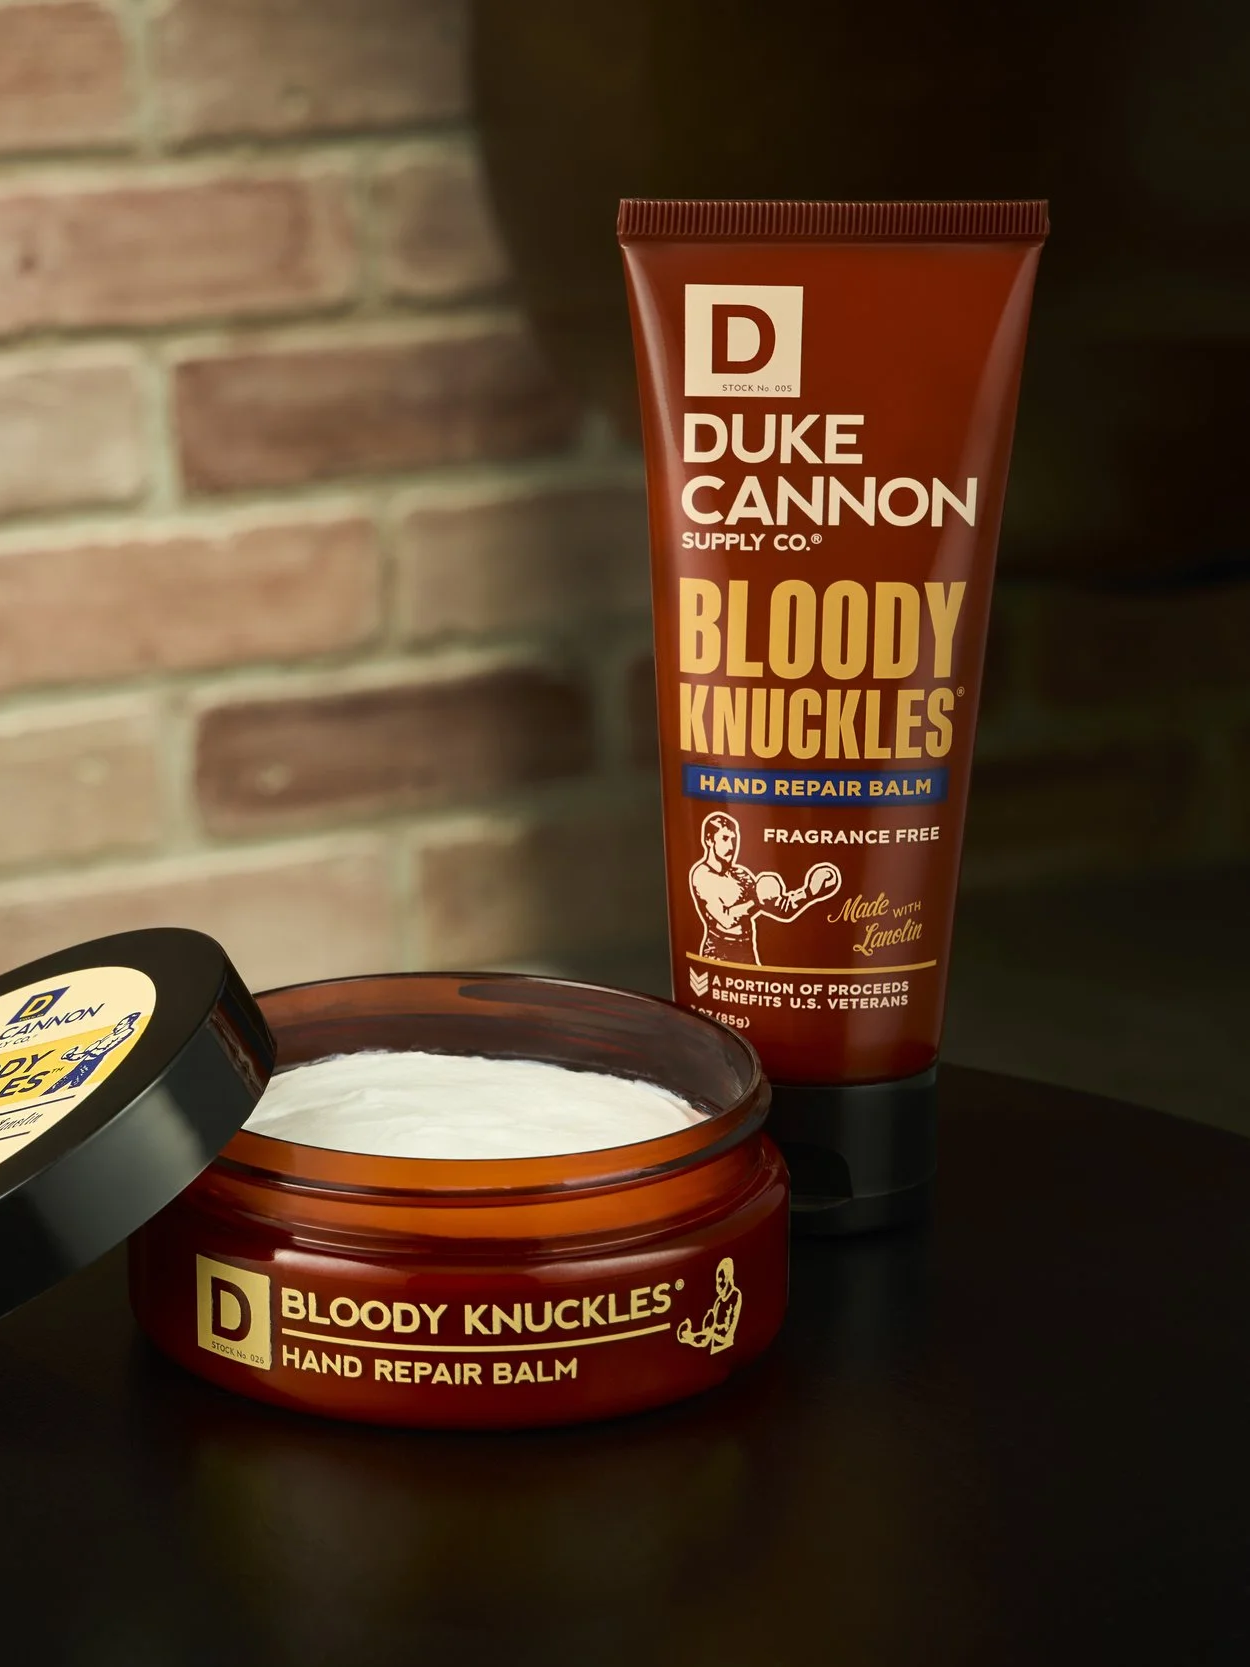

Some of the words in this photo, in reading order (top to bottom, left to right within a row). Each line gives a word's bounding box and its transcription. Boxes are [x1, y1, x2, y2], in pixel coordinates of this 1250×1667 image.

[711, 304, 776, 374] D
[722, 384, 755, 393] STOCK
[774, 385, 793, 393] 005
[683, 413, 865, 465] DUKE
[681, 475, 978, 528] CANNON
[681, 532, 765, 551] SUPPLY
[679, 577, 967, 680] BLOODY
[700, 774, 767, 796] HAND
[774, 779, 861, 797] REPAIR
[869, 778, 931, 797] BALM
[763, 828, 890, 844] FRAGRANCE
[896, 826, 940, 843] FREE
[827, 892, 890, 923] Made
[892, 901, 922, 919] WITH
[853, 918, 923, 957] Lanolin
[712, 975, 722, 988] A
[725, 977, 794, 995] PORTION
[799, 983, 823, 996] OF
[828, 981, 909, 996] PROCEEDS
[712, 989, 782, 1008] BENEFITS
[790, 997, 822, 1010] U.S.
[828, 995, 909, 1010] VETERANS
[0, 1003, 105, 1040] CANNON
[211, 1276, 252, 1342] D
[281, 1287, 448, 1335] BLOODY
[211, 1341, 235, 1356] STOCK
[250, 1354, 265, 1365] 026
[282, 1344, 363, 1378] HAND
[374, 1358, 482, 1386] REPAIR
[493, 1357, 578, 1385] BALM
